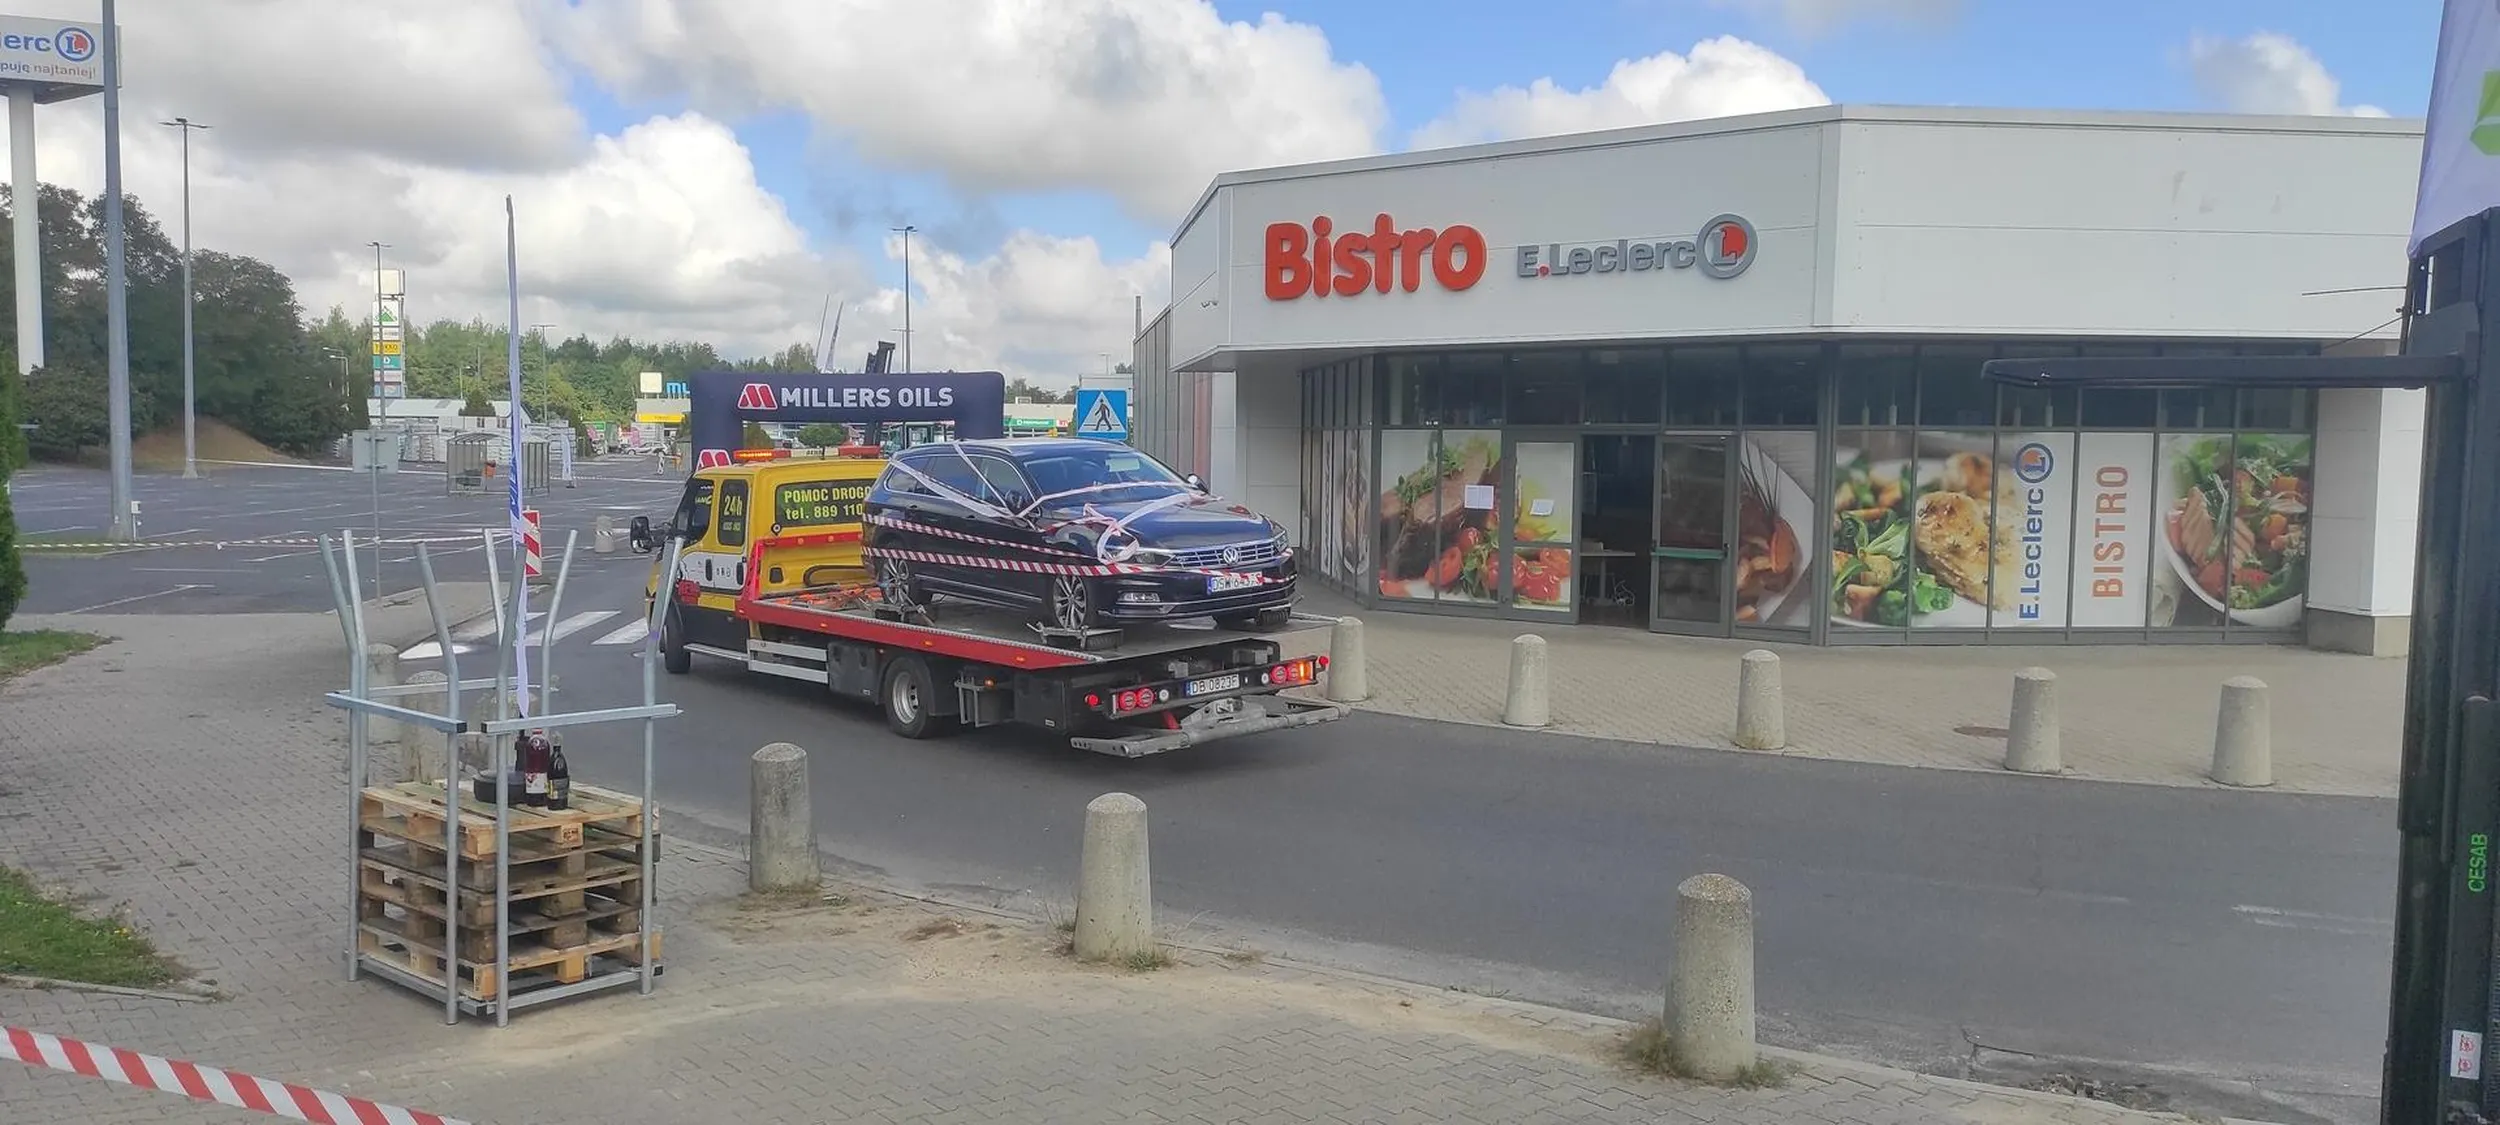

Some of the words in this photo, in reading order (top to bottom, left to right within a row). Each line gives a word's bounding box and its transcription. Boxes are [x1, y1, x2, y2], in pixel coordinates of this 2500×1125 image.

[0, 34, 51, 52] erc
[34, 64, 96, 79] najtaniej!
[1264, 213, 1488, 300] Bistro
[1517, 239, 1696, 278] E.Leclerc
[780, 387, 890, 408] MILLERS
[898, 387, 954, 407] OILS
[723, 495, 743, 516] 24h
[784, 488, 829, 504] POMOC
[785, 508, 810, 521] tel.
[814, 505, 838, 518] 889
[2093, 466, 2129, 598] BISTRO
[2018, 488, 2044, 619] E.Leclerc
[2468, 834, 2488, 891] CESAB
